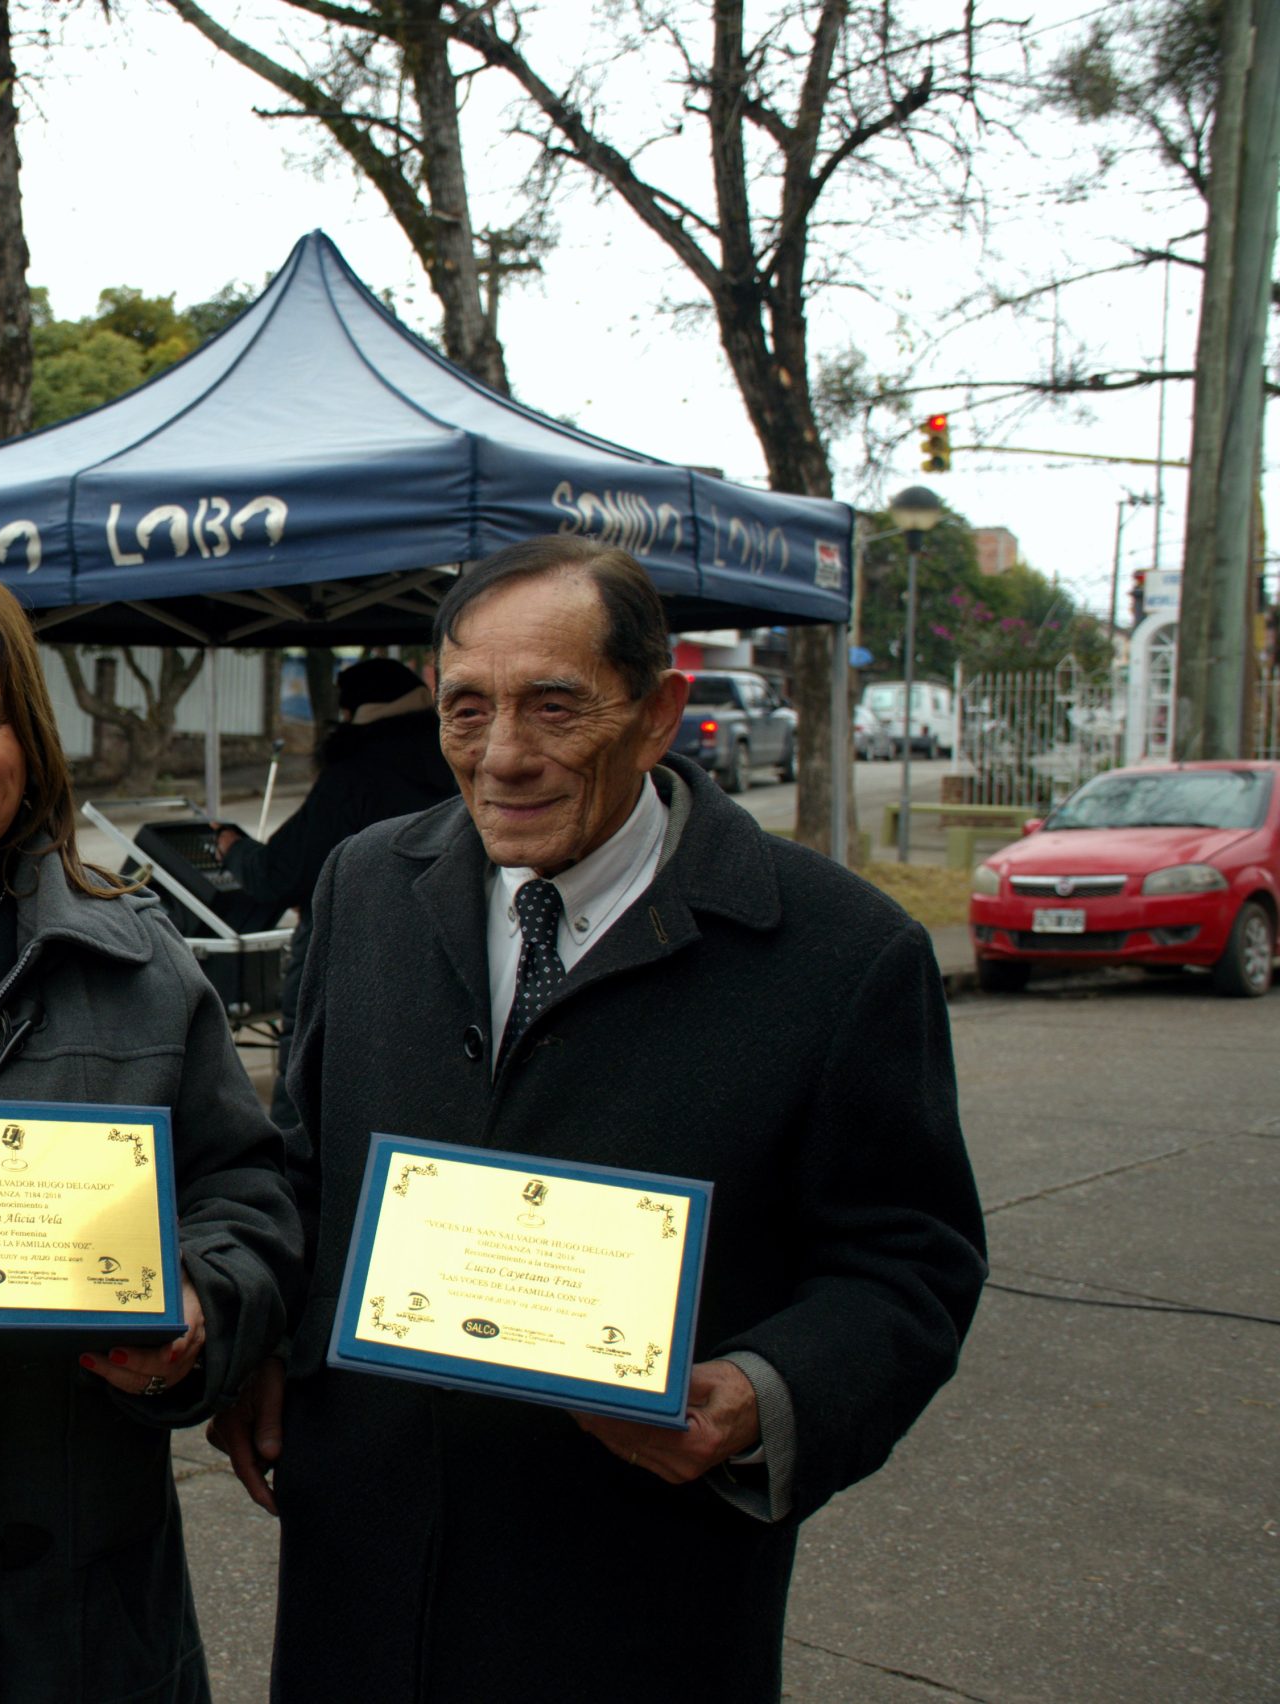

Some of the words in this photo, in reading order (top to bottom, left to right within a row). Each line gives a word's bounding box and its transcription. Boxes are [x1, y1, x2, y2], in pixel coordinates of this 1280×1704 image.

[106, 496, 289, 567] LOBO
[37, 1180, 64, 1188] HUGO
[4, 1212, 34, 1224] Alicia
[38, 1213, 62, 1224] Vela
[10, 1229, 46, 1237] Femenina
[464, 1260, 496, 1275] Lucio
[497, 1265, 550, 1284] Cayetano
[459, 1275, 488, 1287] VOCES
[489, 1281, 503, 1290] DE
[504, 1283, 516, 1292] LA
[517, 1285, 555, 1298] FAMILIA
[556, 1292, 576, 1302] CON
[465, 1321, 496, 1335] SALCo
